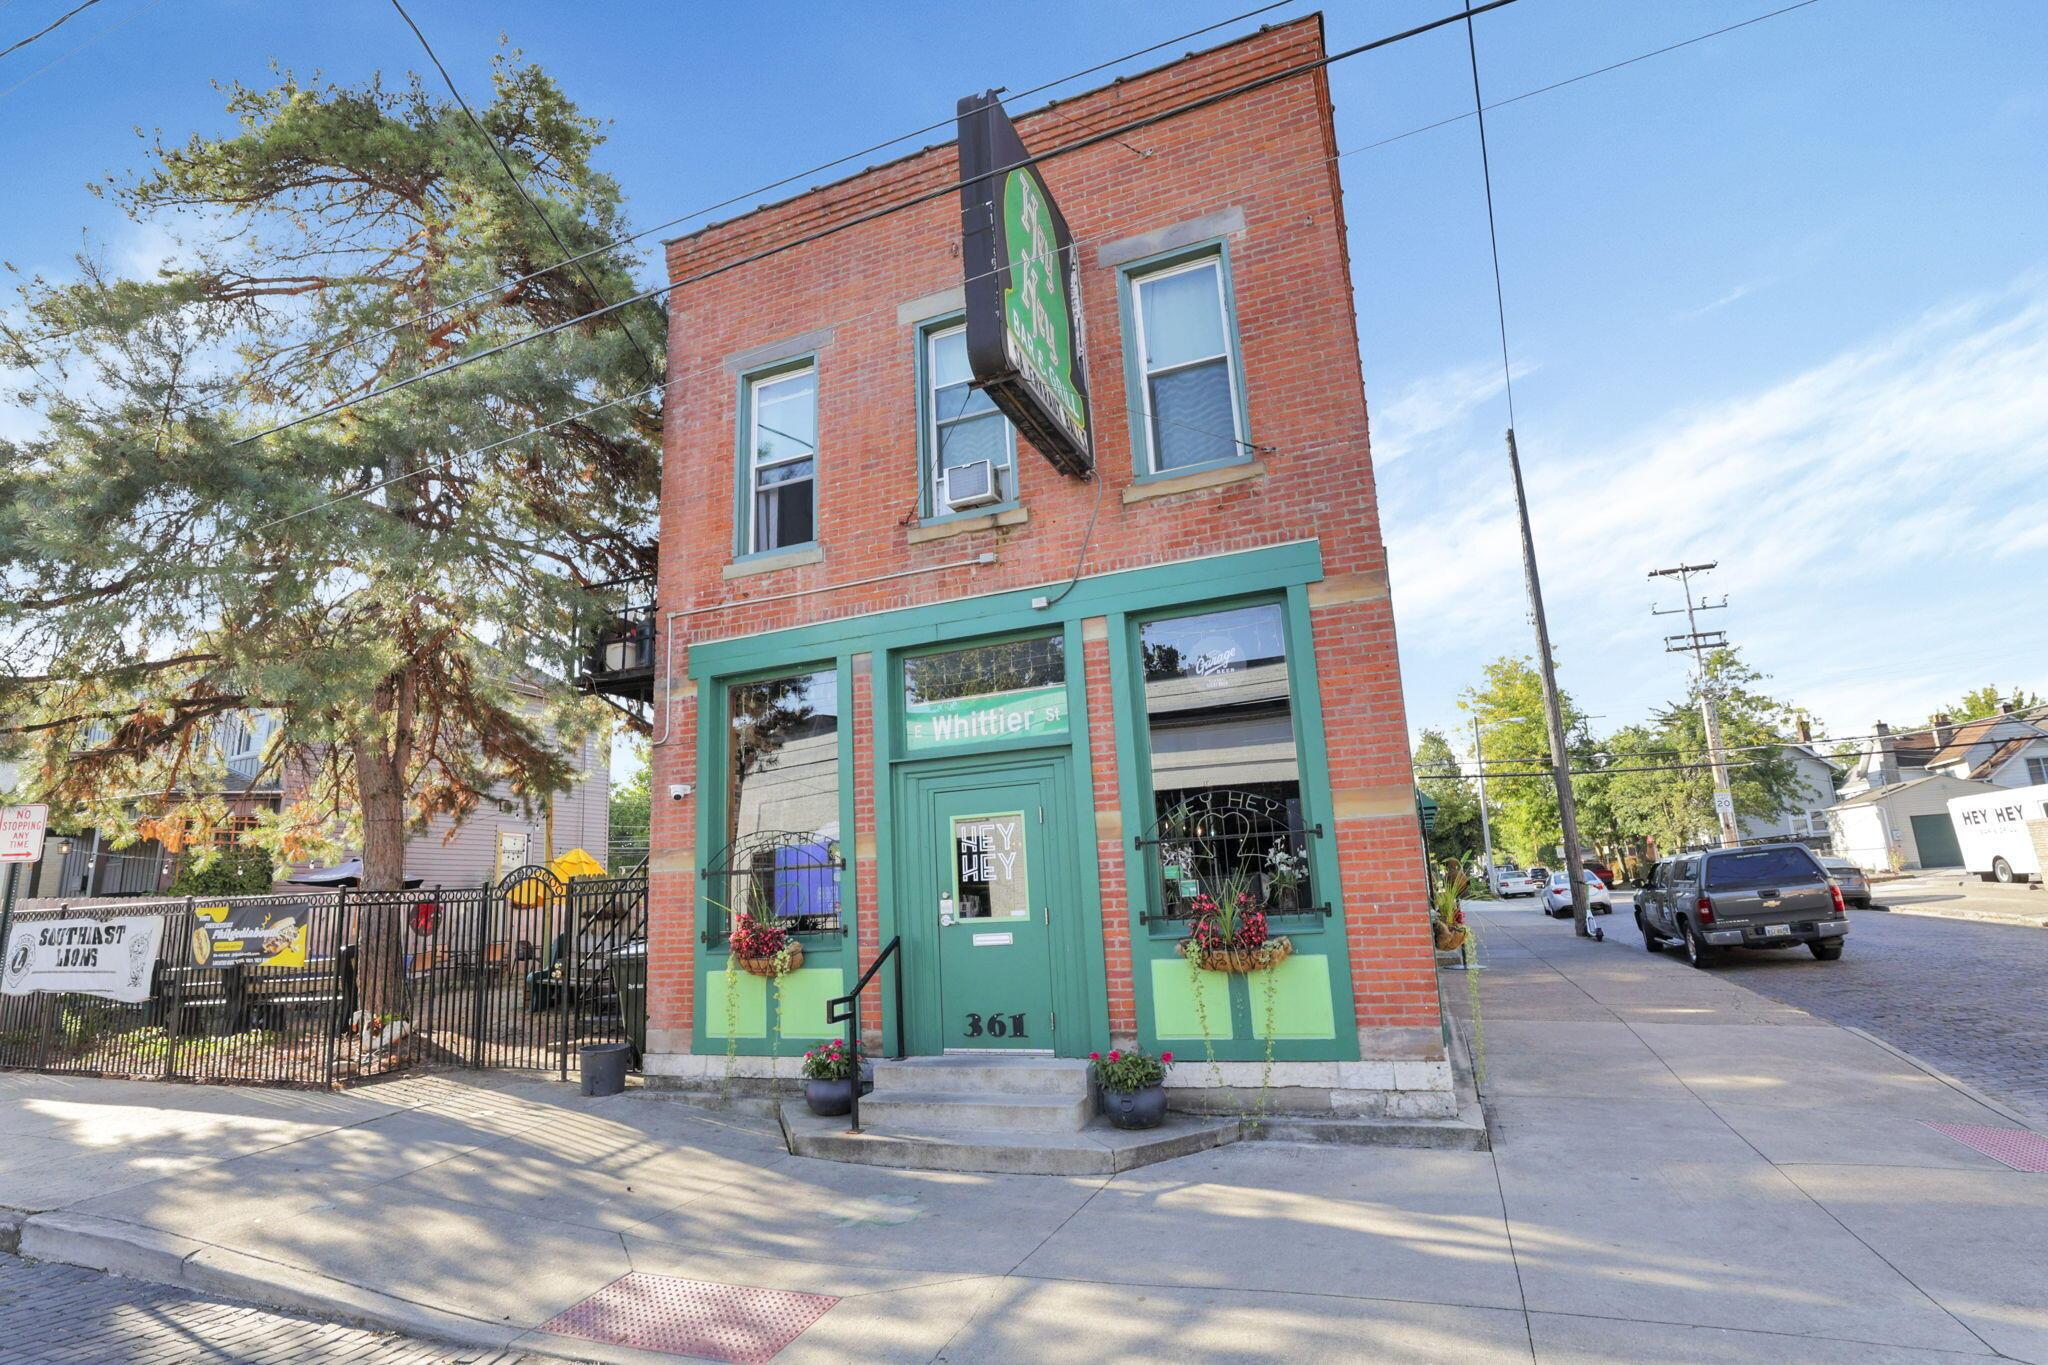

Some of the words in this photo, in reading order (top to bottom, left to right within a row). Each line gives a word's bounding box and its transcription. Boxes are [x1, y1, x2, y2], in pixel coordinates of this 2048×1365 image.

[1012, 308, 1036, 362] BAR
[1048, 366, 1080, 419] GRILL
[1195, 647, 1236, 676] Garage
[914, 724, 922, 738] E
[932, 708, 1034, 741] Whittier
[1045, 707, 1061, 722] St
[16, 810, 32, 819] NO
[1166, 793, 1212, 825] HEY
[1227, 790, 1279, 816] HEY
[1961, 809, 1988, 826] HEY
[1994, 805, 2024, 823] HEY
[2, 821, 42, 831] STOPPING
[12, 832, 30, 840] ANY
[960, 822, 1015, 853] HEY
[10, 840, 30, 849] TIME
[962, 852, 1017, 882] HEY
[55, 948, 99, 967] LIONS
[963, 1012, 1029, 1038] 361
